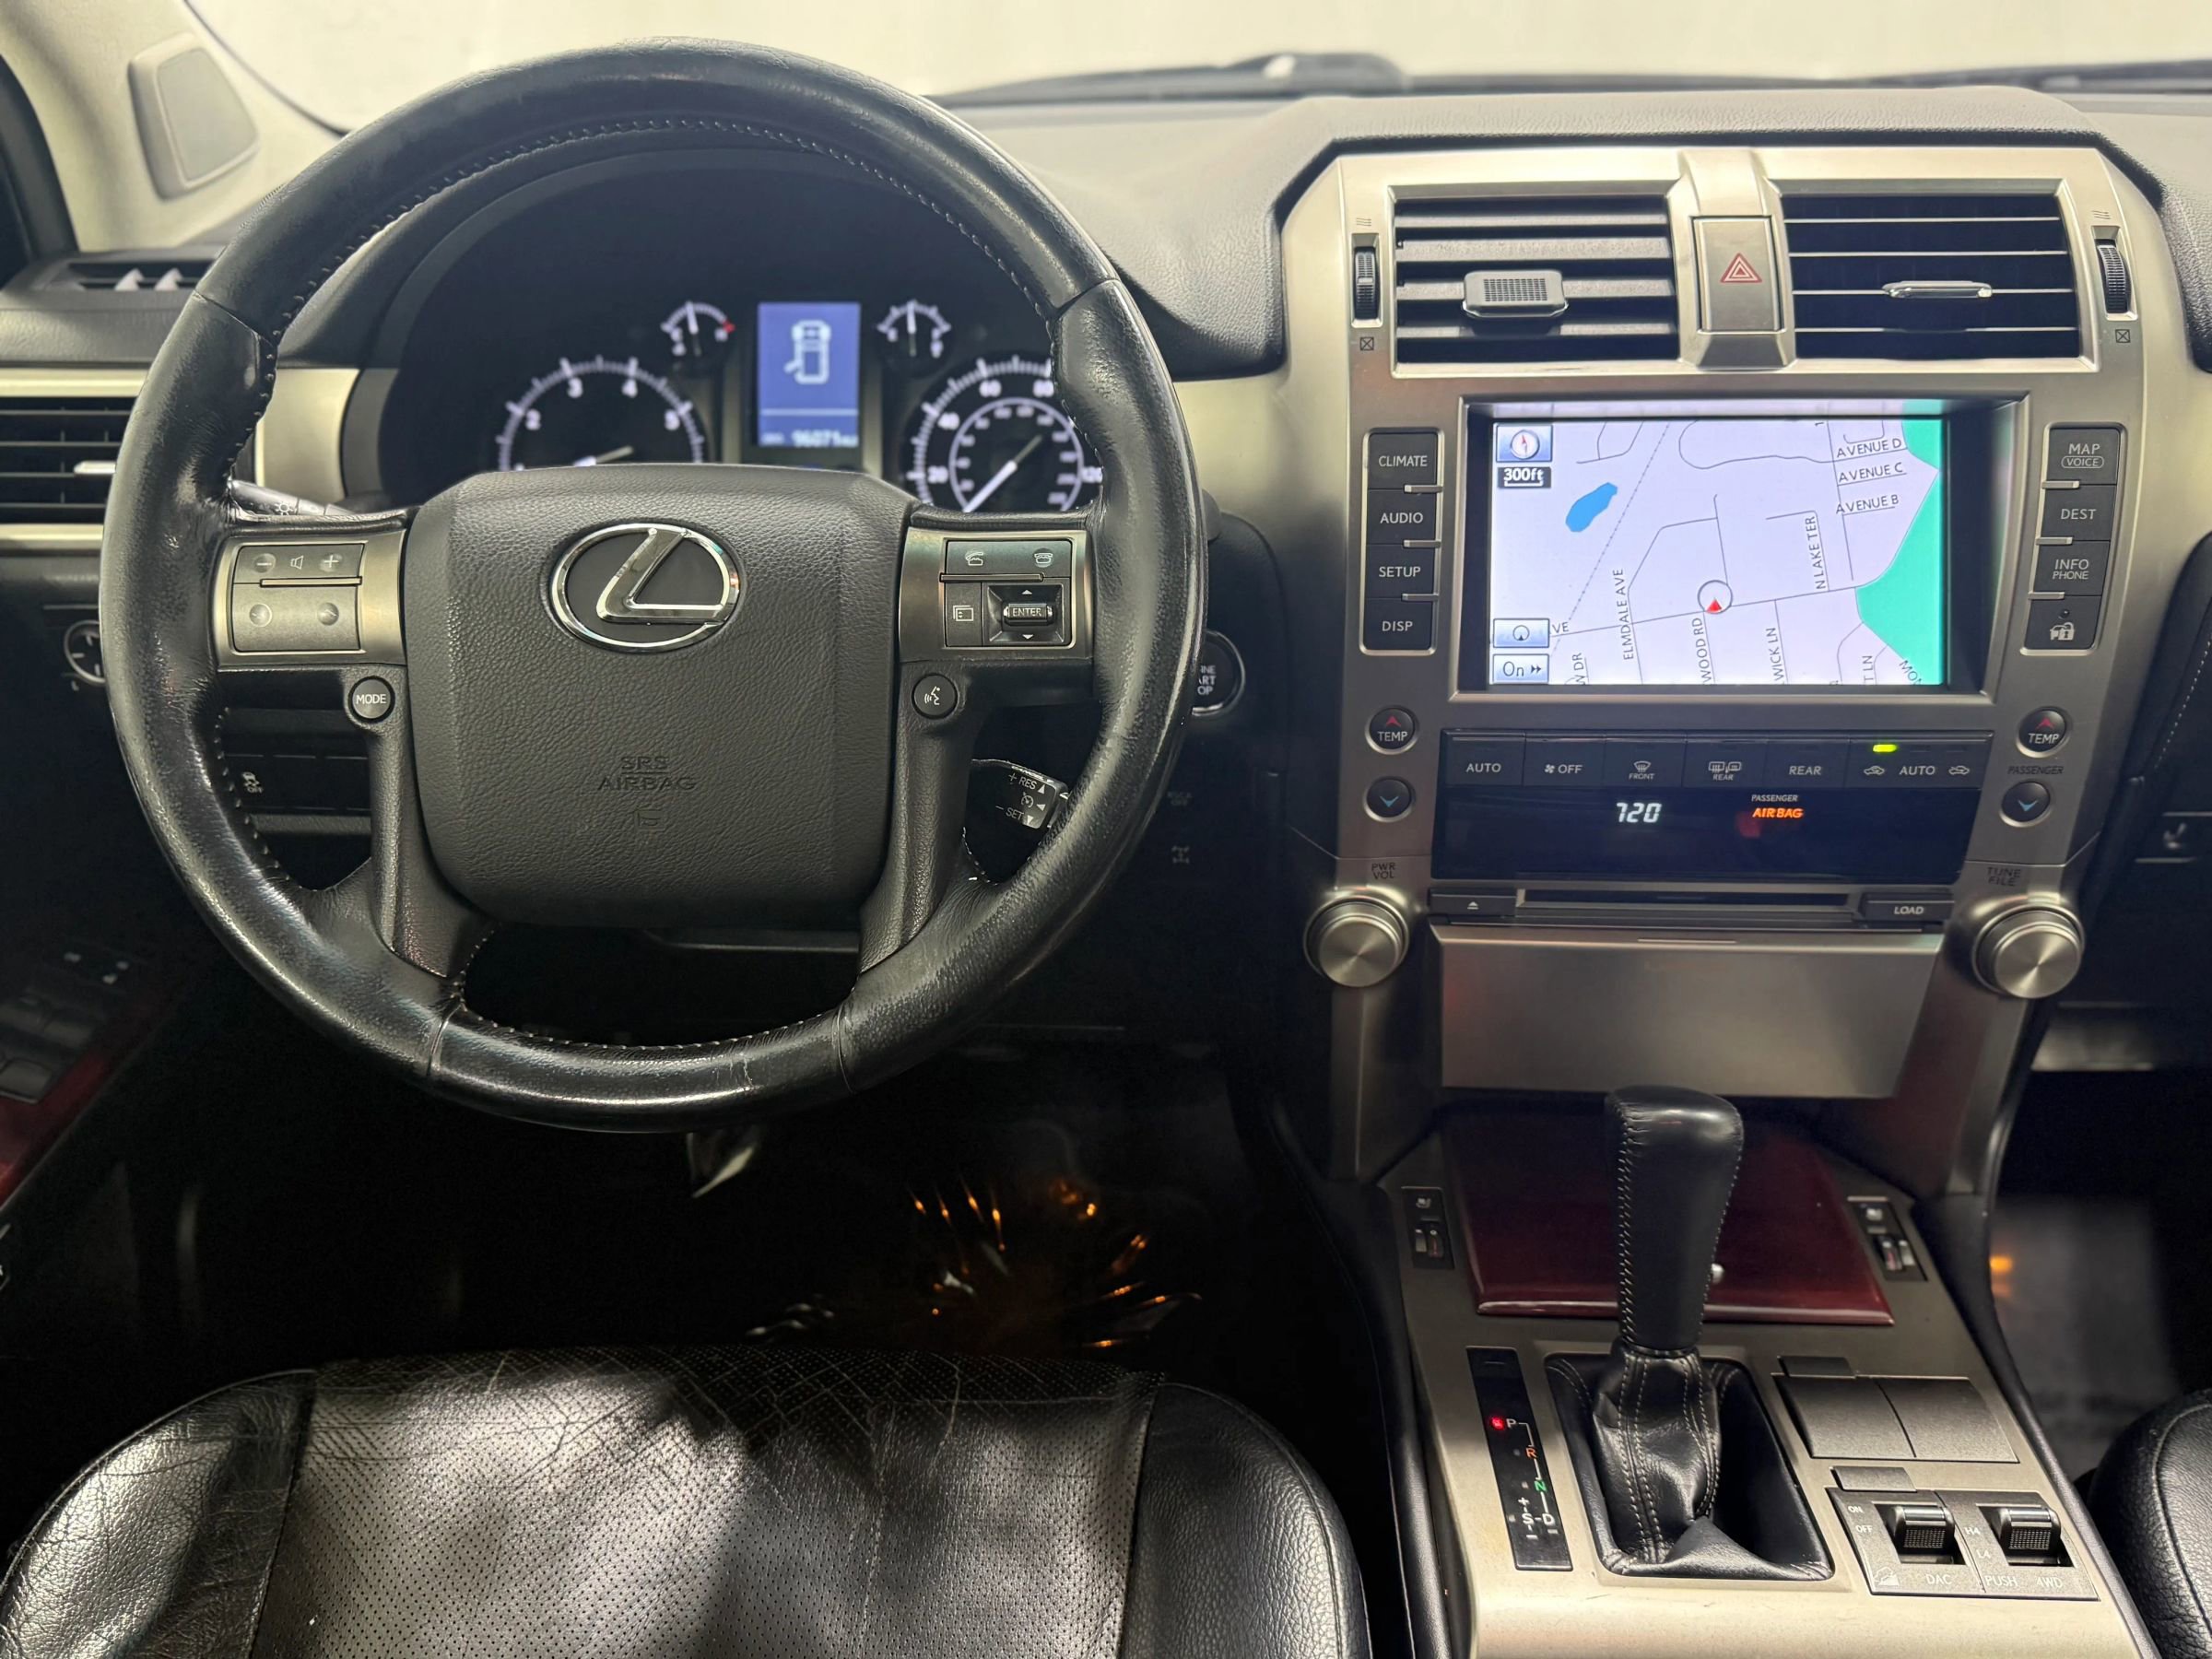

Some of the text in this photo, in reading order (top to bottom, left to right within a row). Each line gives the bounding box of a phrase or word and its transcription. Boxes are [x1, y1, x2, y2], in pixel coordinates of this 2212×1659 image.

[1836, 438, 1902, 459] AVENUE D
[2068, 442, 2100, 454] MAP
[1378, 455, 1428, 467] CLIMATE
[2066, 458, 2100, 467] VOICE
[1503, 467, 1545, 481] 300ft
[1838, 461, 1903, 483] AVENUE C
[1835, 493, 1900, 514] AVENUE B
[1380, 512, 1423, 524] AUDIO
[2060, 509, 2096, 520] DEST
[1804, 515, 1818, 540] TER
[1808, 544, 1824, 578] LAKE
[2054, 559, 2088, 570] INFO
[1378, 566, 1421, 578] SETUP
[2052, 571, 2089, 580] PHONE
[1012, 606, 1042, 617] ENTER
[1612, 569, 1634, 660] ELMDALE AVE
[1382, 620, 1413, 631] DISP
[1551, 621, 1569, 634] VE
[1765, 627, 1779, 644] LN
[1571, 652, 1584, 671] DR
[1861, 655, 1874, 672] LN
[1502, 661, 1524, 677] On
[356, 693, 387, 704] MODE
[1378, 731, 1408, 742] TEMP
[2028, 733, 2059, 744] TEMP
[1465, 762, 1501, 773] AUTO
[1558, 764, 1583, 774] OFF
[1789, 765, 1821, 776] REAR
[1899, 764, 1936, 776] AUTO
[2007, 765, 2064, 775] PASSENGER
[1018, 776, 1038, 790] RES
[1751, 794, 1798, 802] PASSENGER
[1006, 806, 1025, 820] SET
[1752, 807, 1804, 818] AIRBAG
[1371, 862, 1396, 872] PWR
[1987, 866, 2021, 877] TUNE
[1988, 877, 2017, 887] FILE
[1894, 905, 1924, 915] LOAD
[1505, 1418, 1517, 1429] P
[1525, 1447, 1537, 1458] R
[1534, 1479, 1547, 1491] N
[1521, 1512, 1554, 1525] S D
[1855, 1525, 1873, 1534] OFF
[1965, 1526, 1981, 1535] H4
[1925, 1574, 1952, 1585] DAC
[1985, 1575, 2064, 1588] PUSH 4WD
